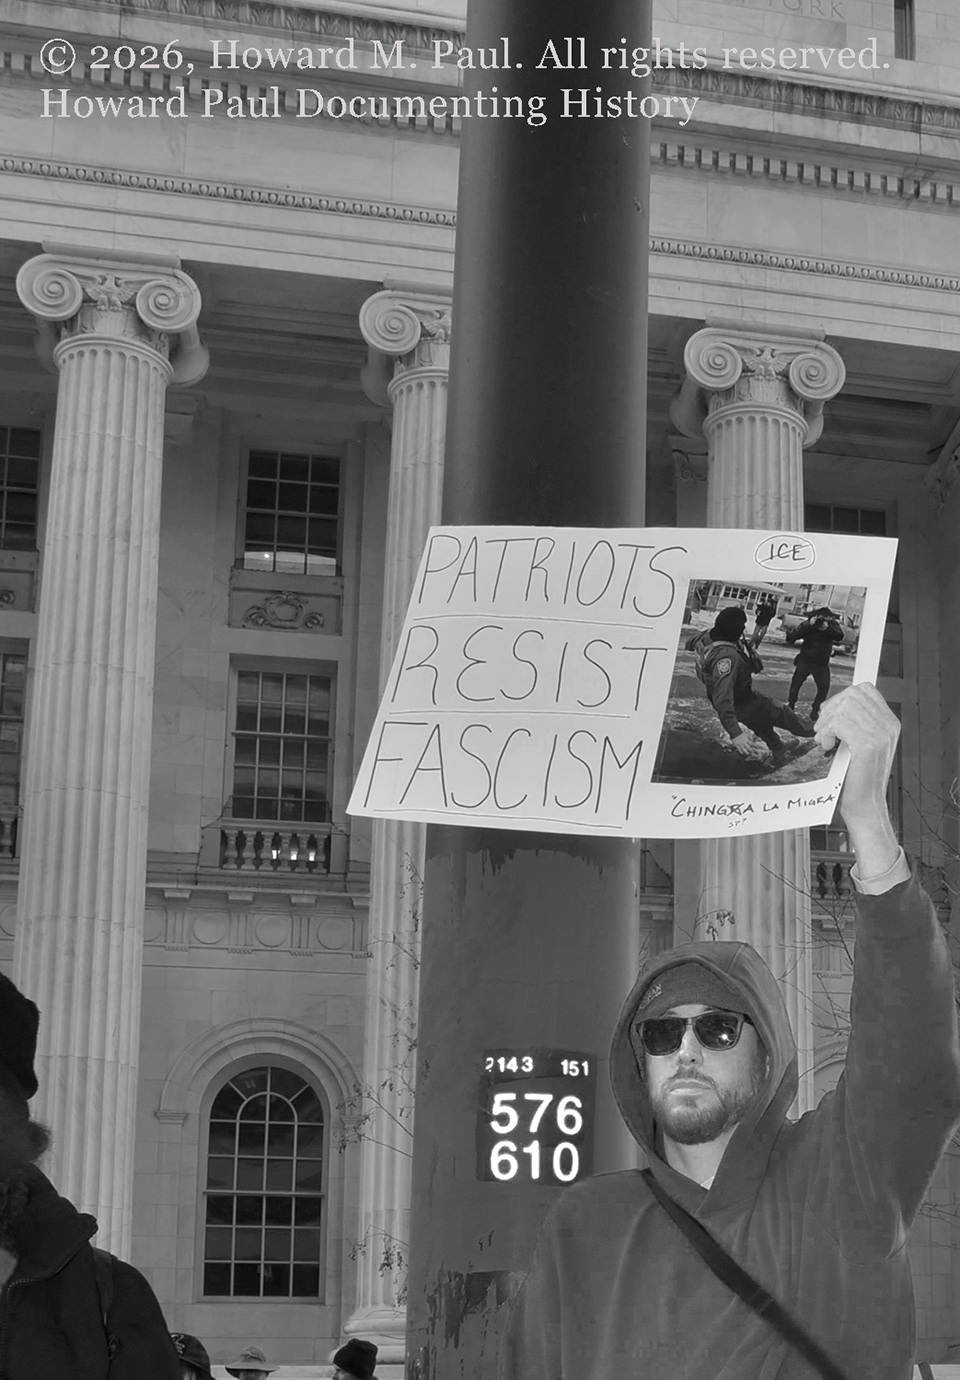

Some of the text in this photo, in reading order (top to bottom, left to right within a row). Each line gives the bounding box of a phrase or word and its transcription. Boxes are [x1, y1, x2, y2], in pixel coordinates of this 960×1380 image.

[770, 543, 806, 561] ICE
[418, 534, 688, 618] PATRIOTS
[391, 624, 668, 711] RESIST
[364, 721, 644, 820] FASCISM
[561, 1059, 589, 1076] 151
[490, 1092, 583, 1135] 576
[490, 1140, 579, 1182] 610
